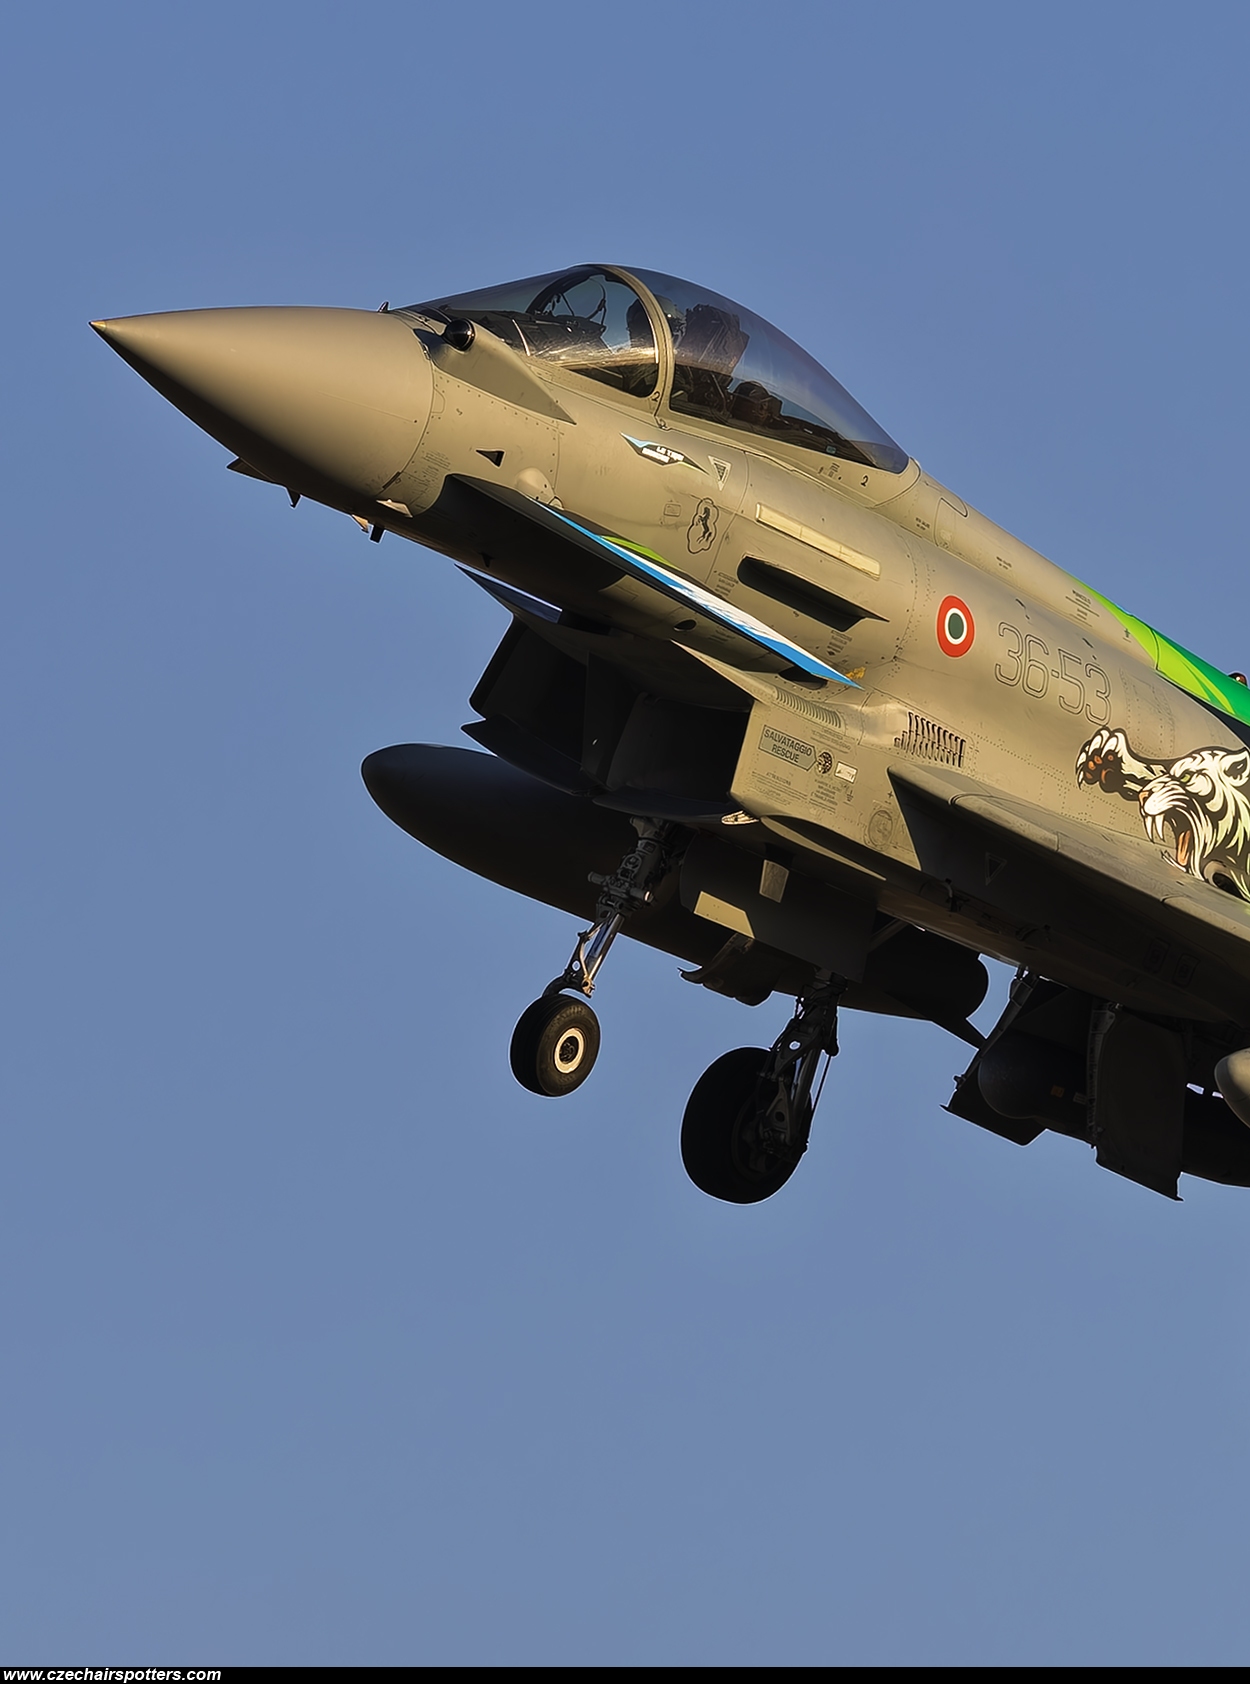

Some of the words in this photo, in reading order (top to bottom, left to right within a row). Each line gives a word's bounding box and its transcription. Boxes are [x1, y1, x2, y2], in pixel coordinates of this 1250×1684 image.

[995, 621, 1111, 726] 36-53
[763, 729, 813, 757] SALVATAGGIO
[771, 744, 800, 763] RESCUE
